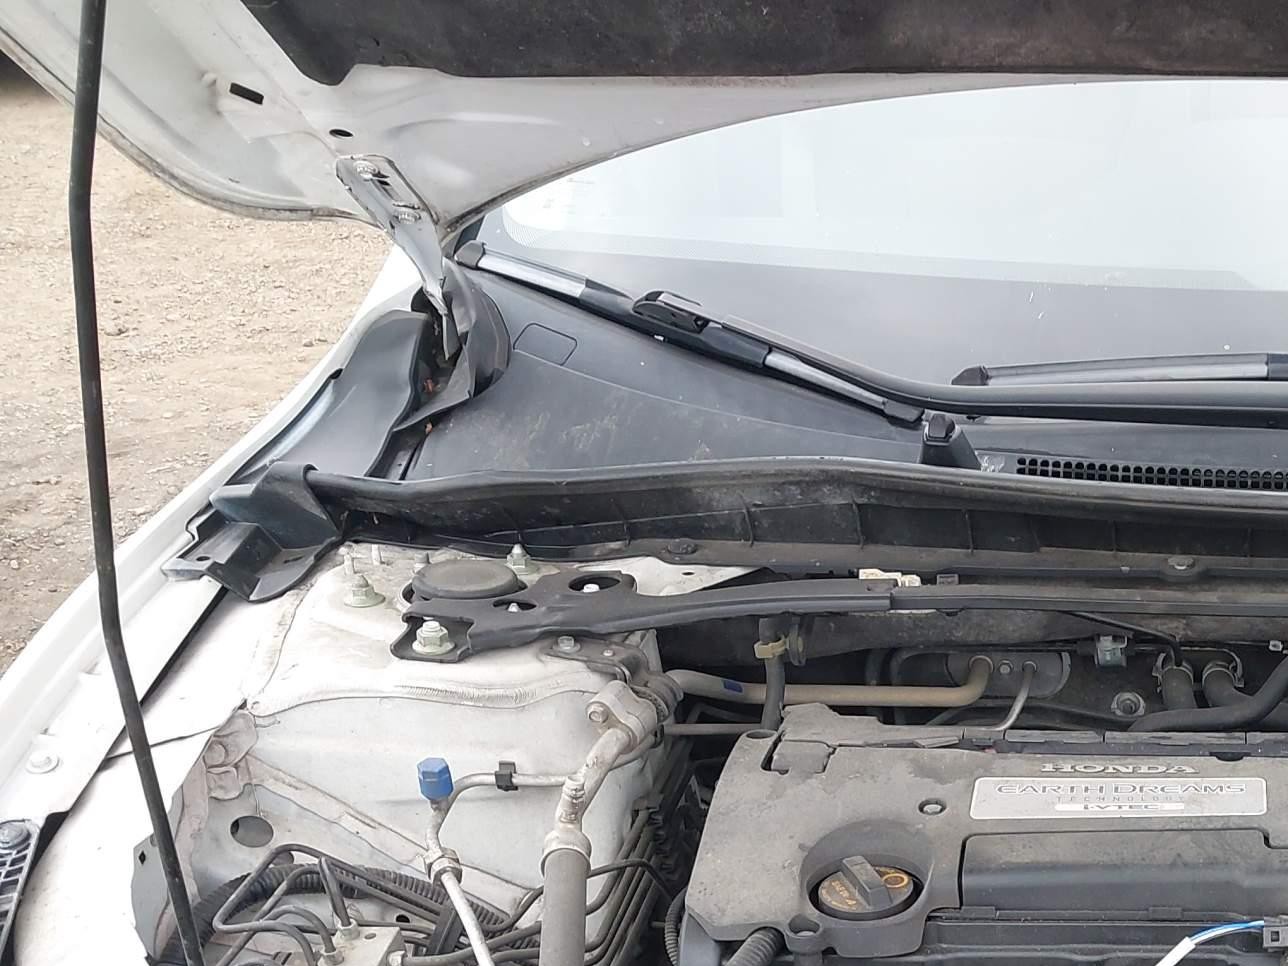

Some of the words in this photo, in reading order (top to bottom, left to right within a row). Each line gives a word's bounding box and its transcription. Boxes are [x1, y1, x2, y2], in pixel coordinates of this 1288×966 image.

[1040, 762, 1200, 775] HONDA
[996, 783, 1104, 794] EARTH
[1113, 783, 1246, 794] DREAMS
